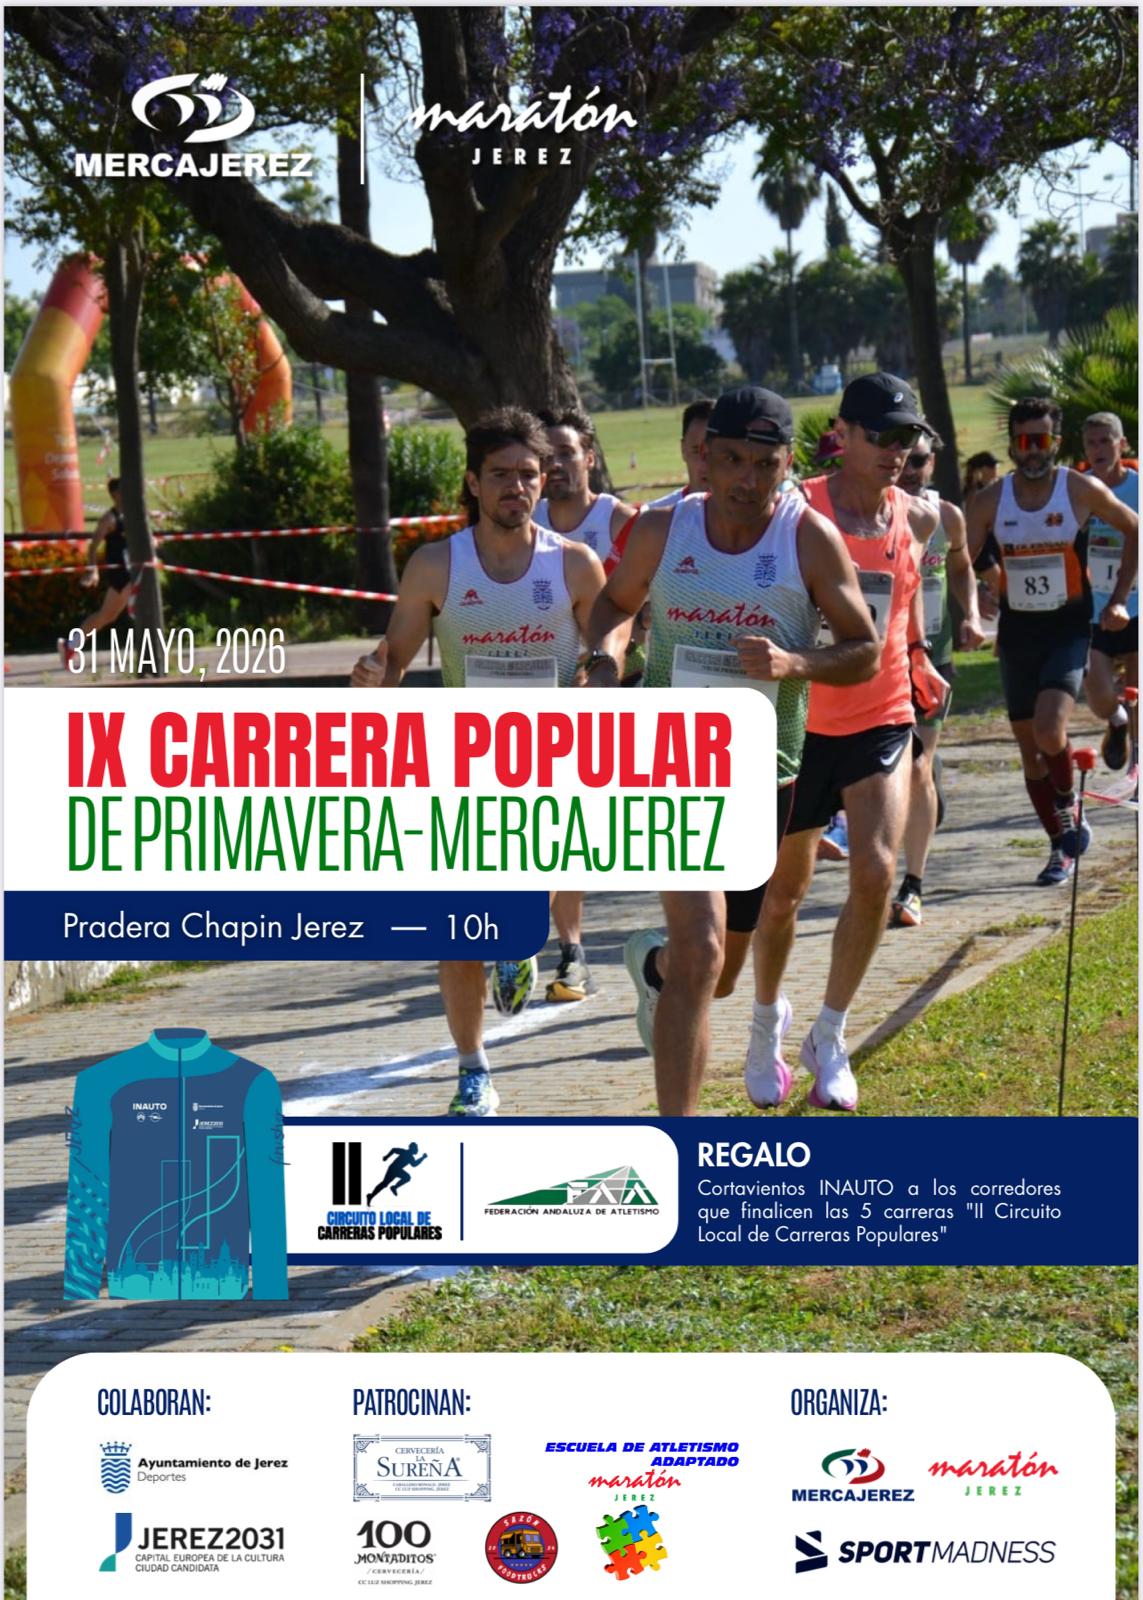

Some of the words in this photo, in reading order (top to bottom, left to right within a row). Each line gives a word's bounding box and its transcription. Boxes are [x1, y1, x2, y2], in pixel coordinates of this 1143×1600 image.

[409, 84, 639, 134] maratón
[74, 153, 313, 177] MERCAJEREZ
[471, 148, 573, 165] JEREZ
[1024, 575, 1050, 596] 83
[668, 602, 776, 626] maratón
[462, 623, 556, 645] maratón
[67, 627, 98, 674] 31
[109, 627, 206, 683] MAYO,
[215, 627, 286, 674] 2026
[69, 712, 126, 787] IX
[150, 712, 430, 788] CARRERA
[455, 712, 731, 788] POPULAR
[69, 796, 122, 871] DE
[65, 911, 169, 938] Pradera
[182, 911, 281, 946] Chapin
[291, 913, 364, 940] Jerez
[448, 913, 498, 940] 10h
[699, 1142, 810, 1167] REGALO
[332, 1142, 361, 1205] II
[698, 1180, 805, 1195] Cortavientos
[821, 1180, 893, 1195] INAUTO
[908, 1185, 918, 1195] a
[934, 1178, 956, 1195] los
[971, 1178, 1061, 1195] corredores
[327, 1211, 376, 1226] CIRCUITO
[380, 1211, 414, 1226] LOCAL
[417, 1211, 431, 1226] DE
[698, 1208, 729, 1223] que
[742, 1201, 812, 1218] finalicen
[826, 1202, 848, 1218] las
[861, 1203, 871, 1218] 5
[884, 1208, 953, 1218] carreras
[995, 1203, 1061, 1218] Circuito
[318, 1226, 375, 1240] CARRERAS
[378, 1226, 442, 1240] POPULARES
[699, 1225, 741, 1241] Local
[748, 1225, 769, 1241] de
[776, 1226, 849, 1242] Carreras
[857, 1225, 946, 1247] Populares"
[98, 1389, 210, 1415] COLABORAN:
[354, 1389, 470, 1415] PATROCINAN:
[791, 1389, 887, 1415] ORGANIZA:
[545, 1443, 617, 1452] ESCUELA
[623, 1443, 645, 1452] DE
[649, 1442, 739, 1452] ATLETISMO
[138, 1458, 231, 1470] Ayuntamiento
[235, 1458, 250, 1467] de
[254, 1458, 288, 1470] Jerez
[376, 1456, 462, 1478] SUREÑA
[651, 1457, 739, 1467] ADAPTADO
[928, 1451, 1058, 1478] maratón
[138, 1472, 186, 1483] Deportes
[589, 1469, 681, 1488] maratón
[792, 1489, 914, 1501] MERCAJEREZ
[965, 1486, 1021, 1496] JEREZ
[503, 1515, 540, 1526] SAZÓN
[138, 1528, 283, 1550] JEREZ2031
[357, 1520, 431, 1548] 100
[135, 1554, 170, 1562] CAPITAL
[174, 1554, 214, 1562] EUROPEA
[245, 1554, 284, 1562] CULTURA
[353, 1551, 434, 1565] MONTADITOS
[839, 1541, 1056, 1563] SPORTMADNESS
[136, 1564, 169, 1572] CIUDAD
[171, 1564, 219, 1572] CANDIDATA
